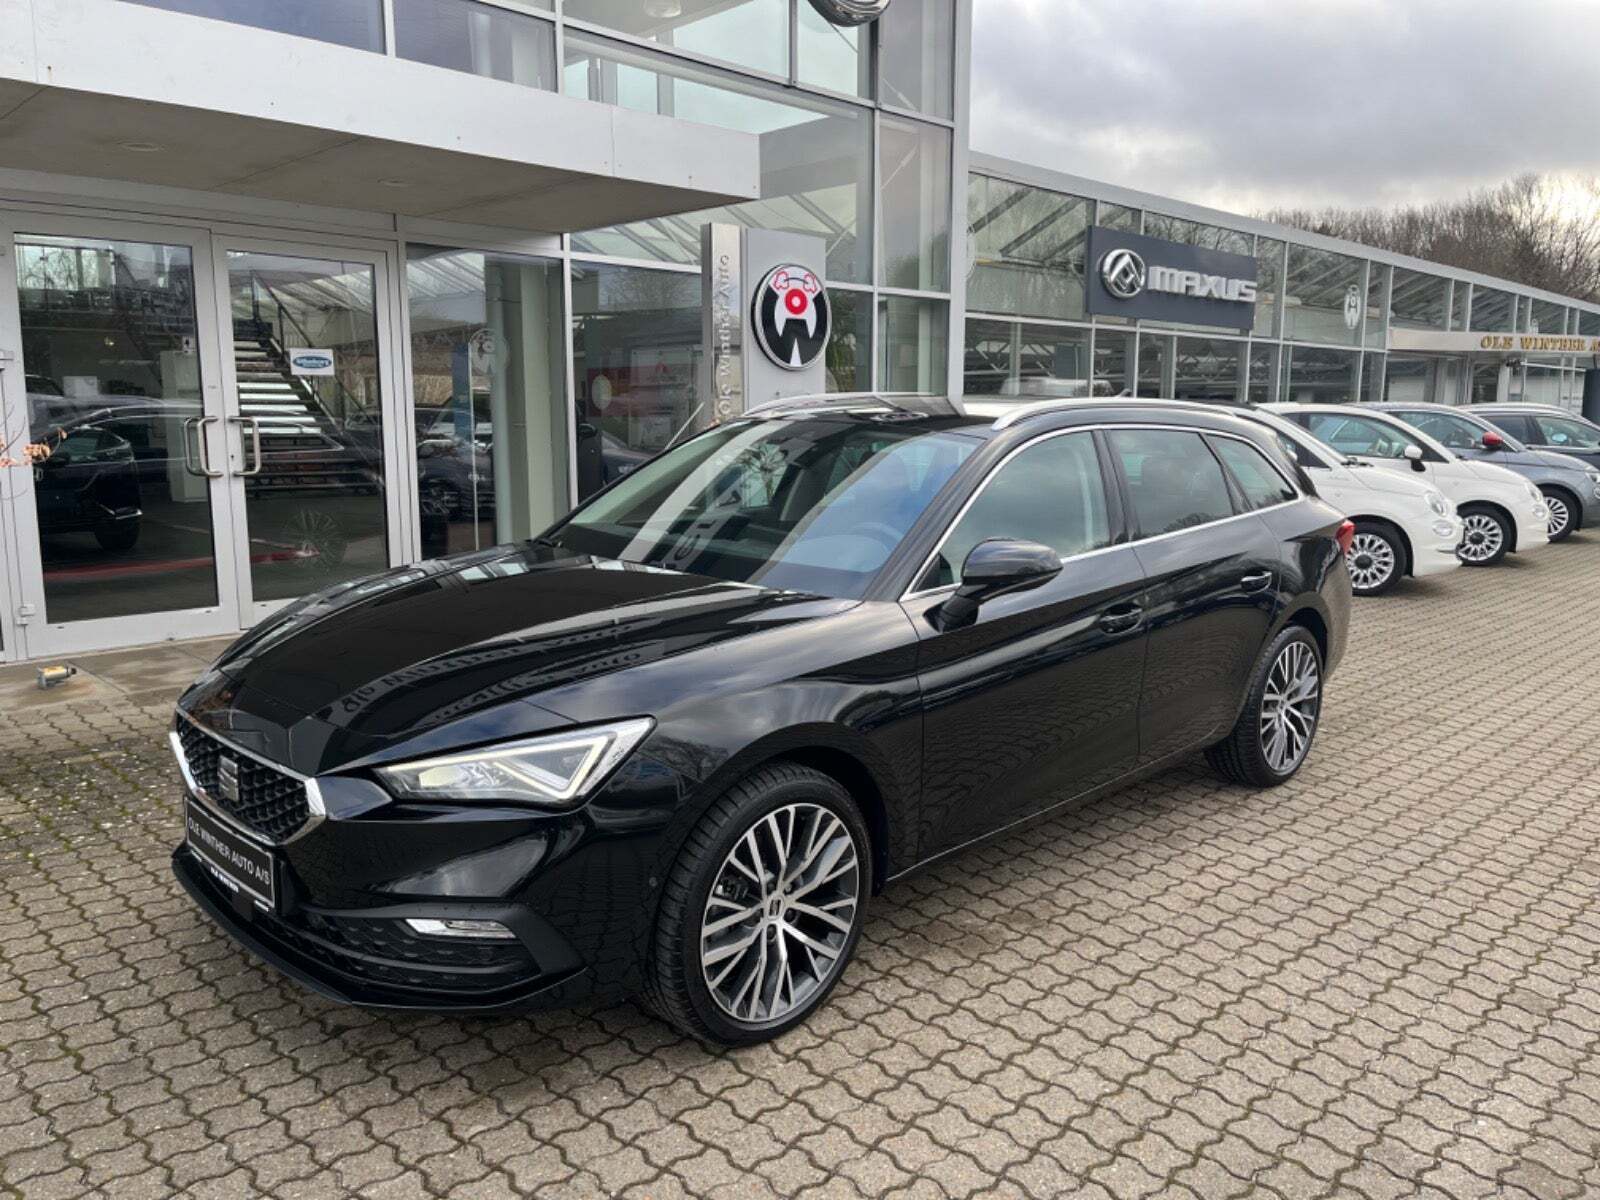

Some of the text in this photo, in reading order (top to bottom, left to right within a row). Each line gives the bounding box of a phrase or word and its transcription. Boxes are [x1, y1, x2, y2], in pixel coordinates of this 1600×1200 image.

[1148, 265, 1258, 302] MAXUS
[718, 254, 732, 415] Ole Winther Auto
[1480, 335, 1514, 350] OLE
[1520, 336, 1586, 352] WINTHER
[189, 816, 201, 836] OLE
[200, 827, 231, 860] WINTHER
[231, 850, 254, 875] AUTO
[255, 864, 270, 885] A/S
